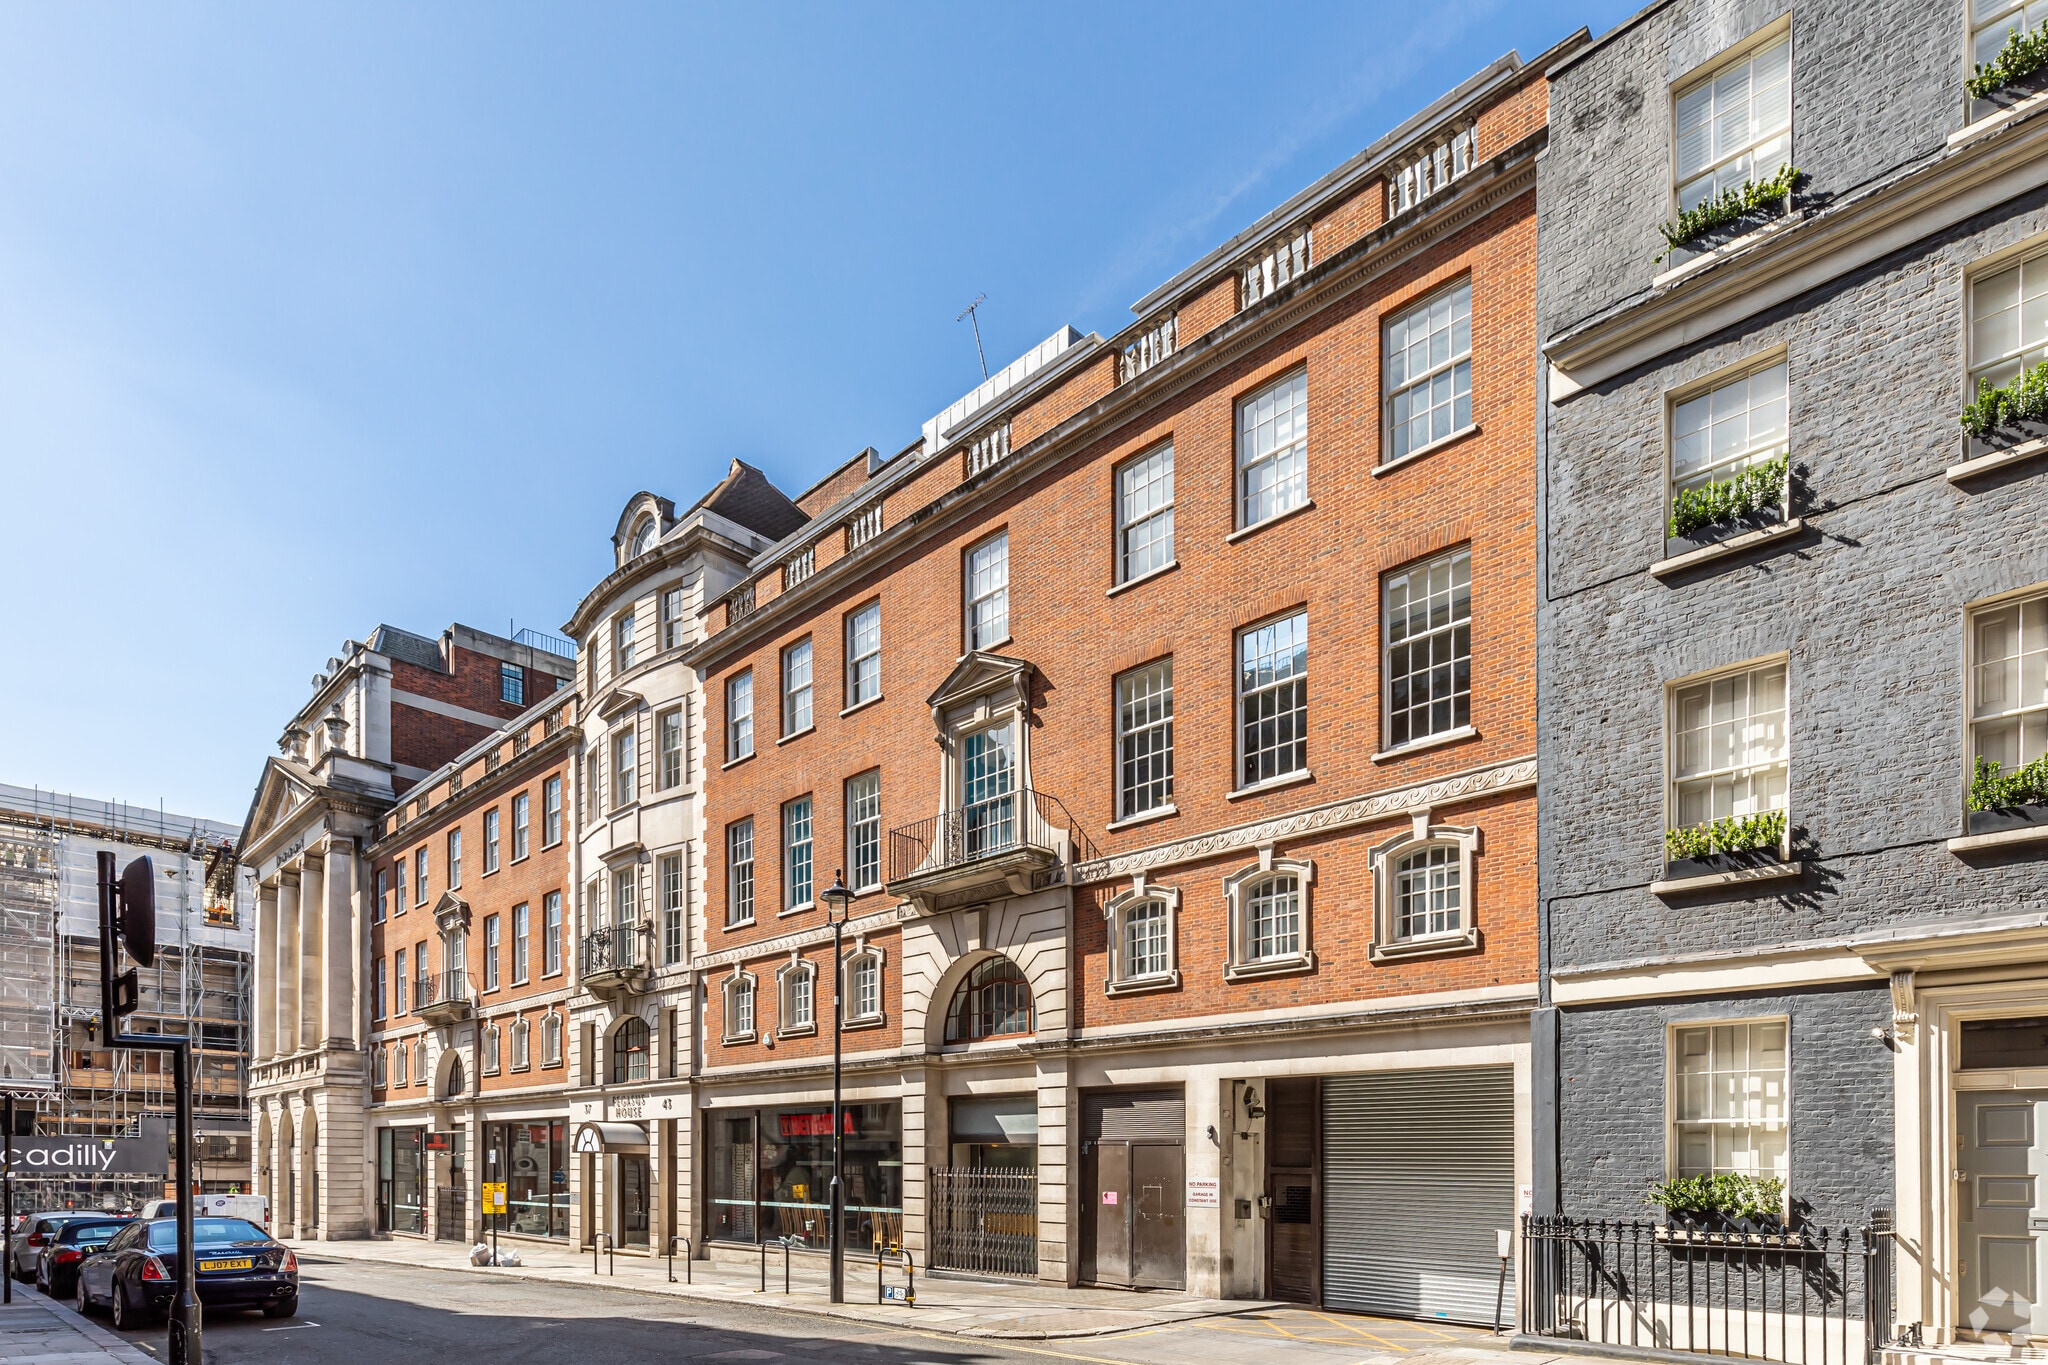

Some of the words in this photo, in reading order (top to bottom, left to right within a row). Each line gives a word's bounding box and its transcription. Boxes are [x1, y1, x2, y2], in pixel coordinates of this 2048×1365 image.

[612, 1094, 646, 1108] PEGASUS
[661, 1098, 672, 1110] 43
[584, 1104, 592, 1115] 37
[615, 1108, 642, 1119] HOUSE
[204, 1261, 228, 1269] LJ07
[230, 1260, 247, 1268] EXT
[887, 1287, 892, 1297] P
